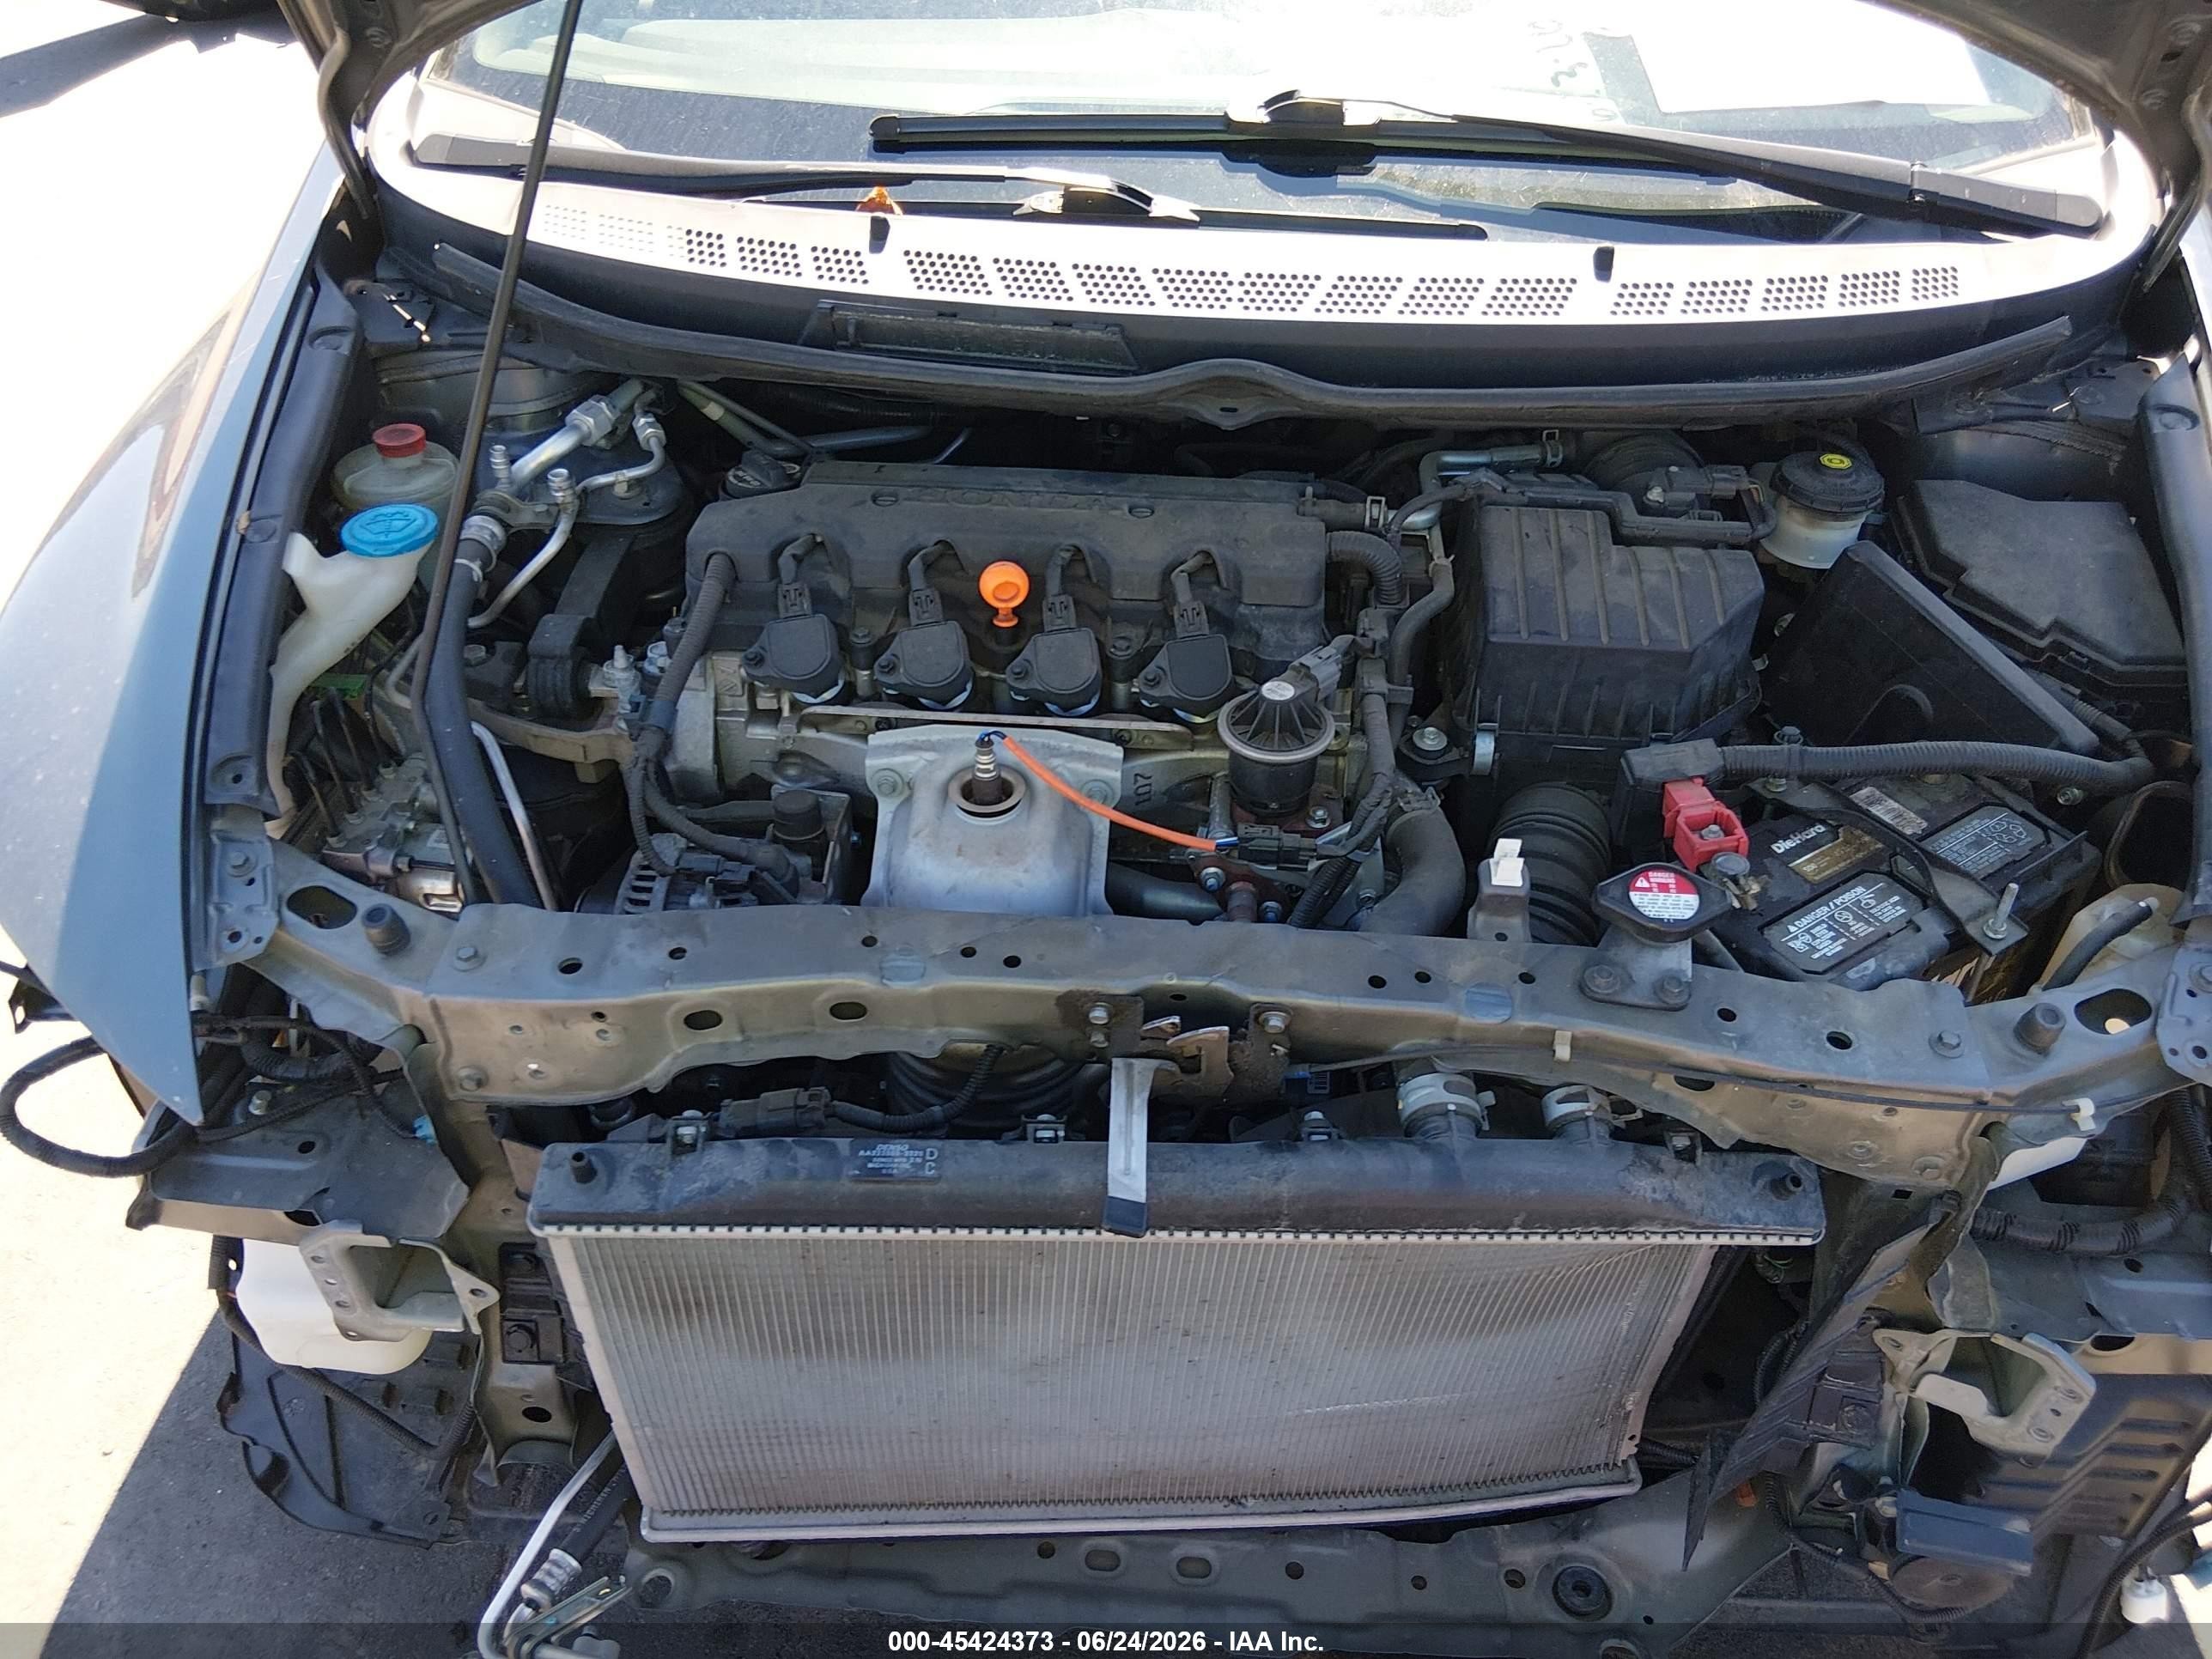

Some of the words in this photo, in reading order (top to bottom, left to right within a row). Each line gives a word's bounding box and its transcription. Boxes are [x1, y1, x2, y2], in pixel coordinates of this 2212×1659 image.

[1771, 823, 1826, 854] DieHard
[1794, 906, 1832, 927] DANGER
[1832, 886, 1867, 906] POISON
[925, 1148, 938, 1160] D
[925, 1162, 936, 1175] C
